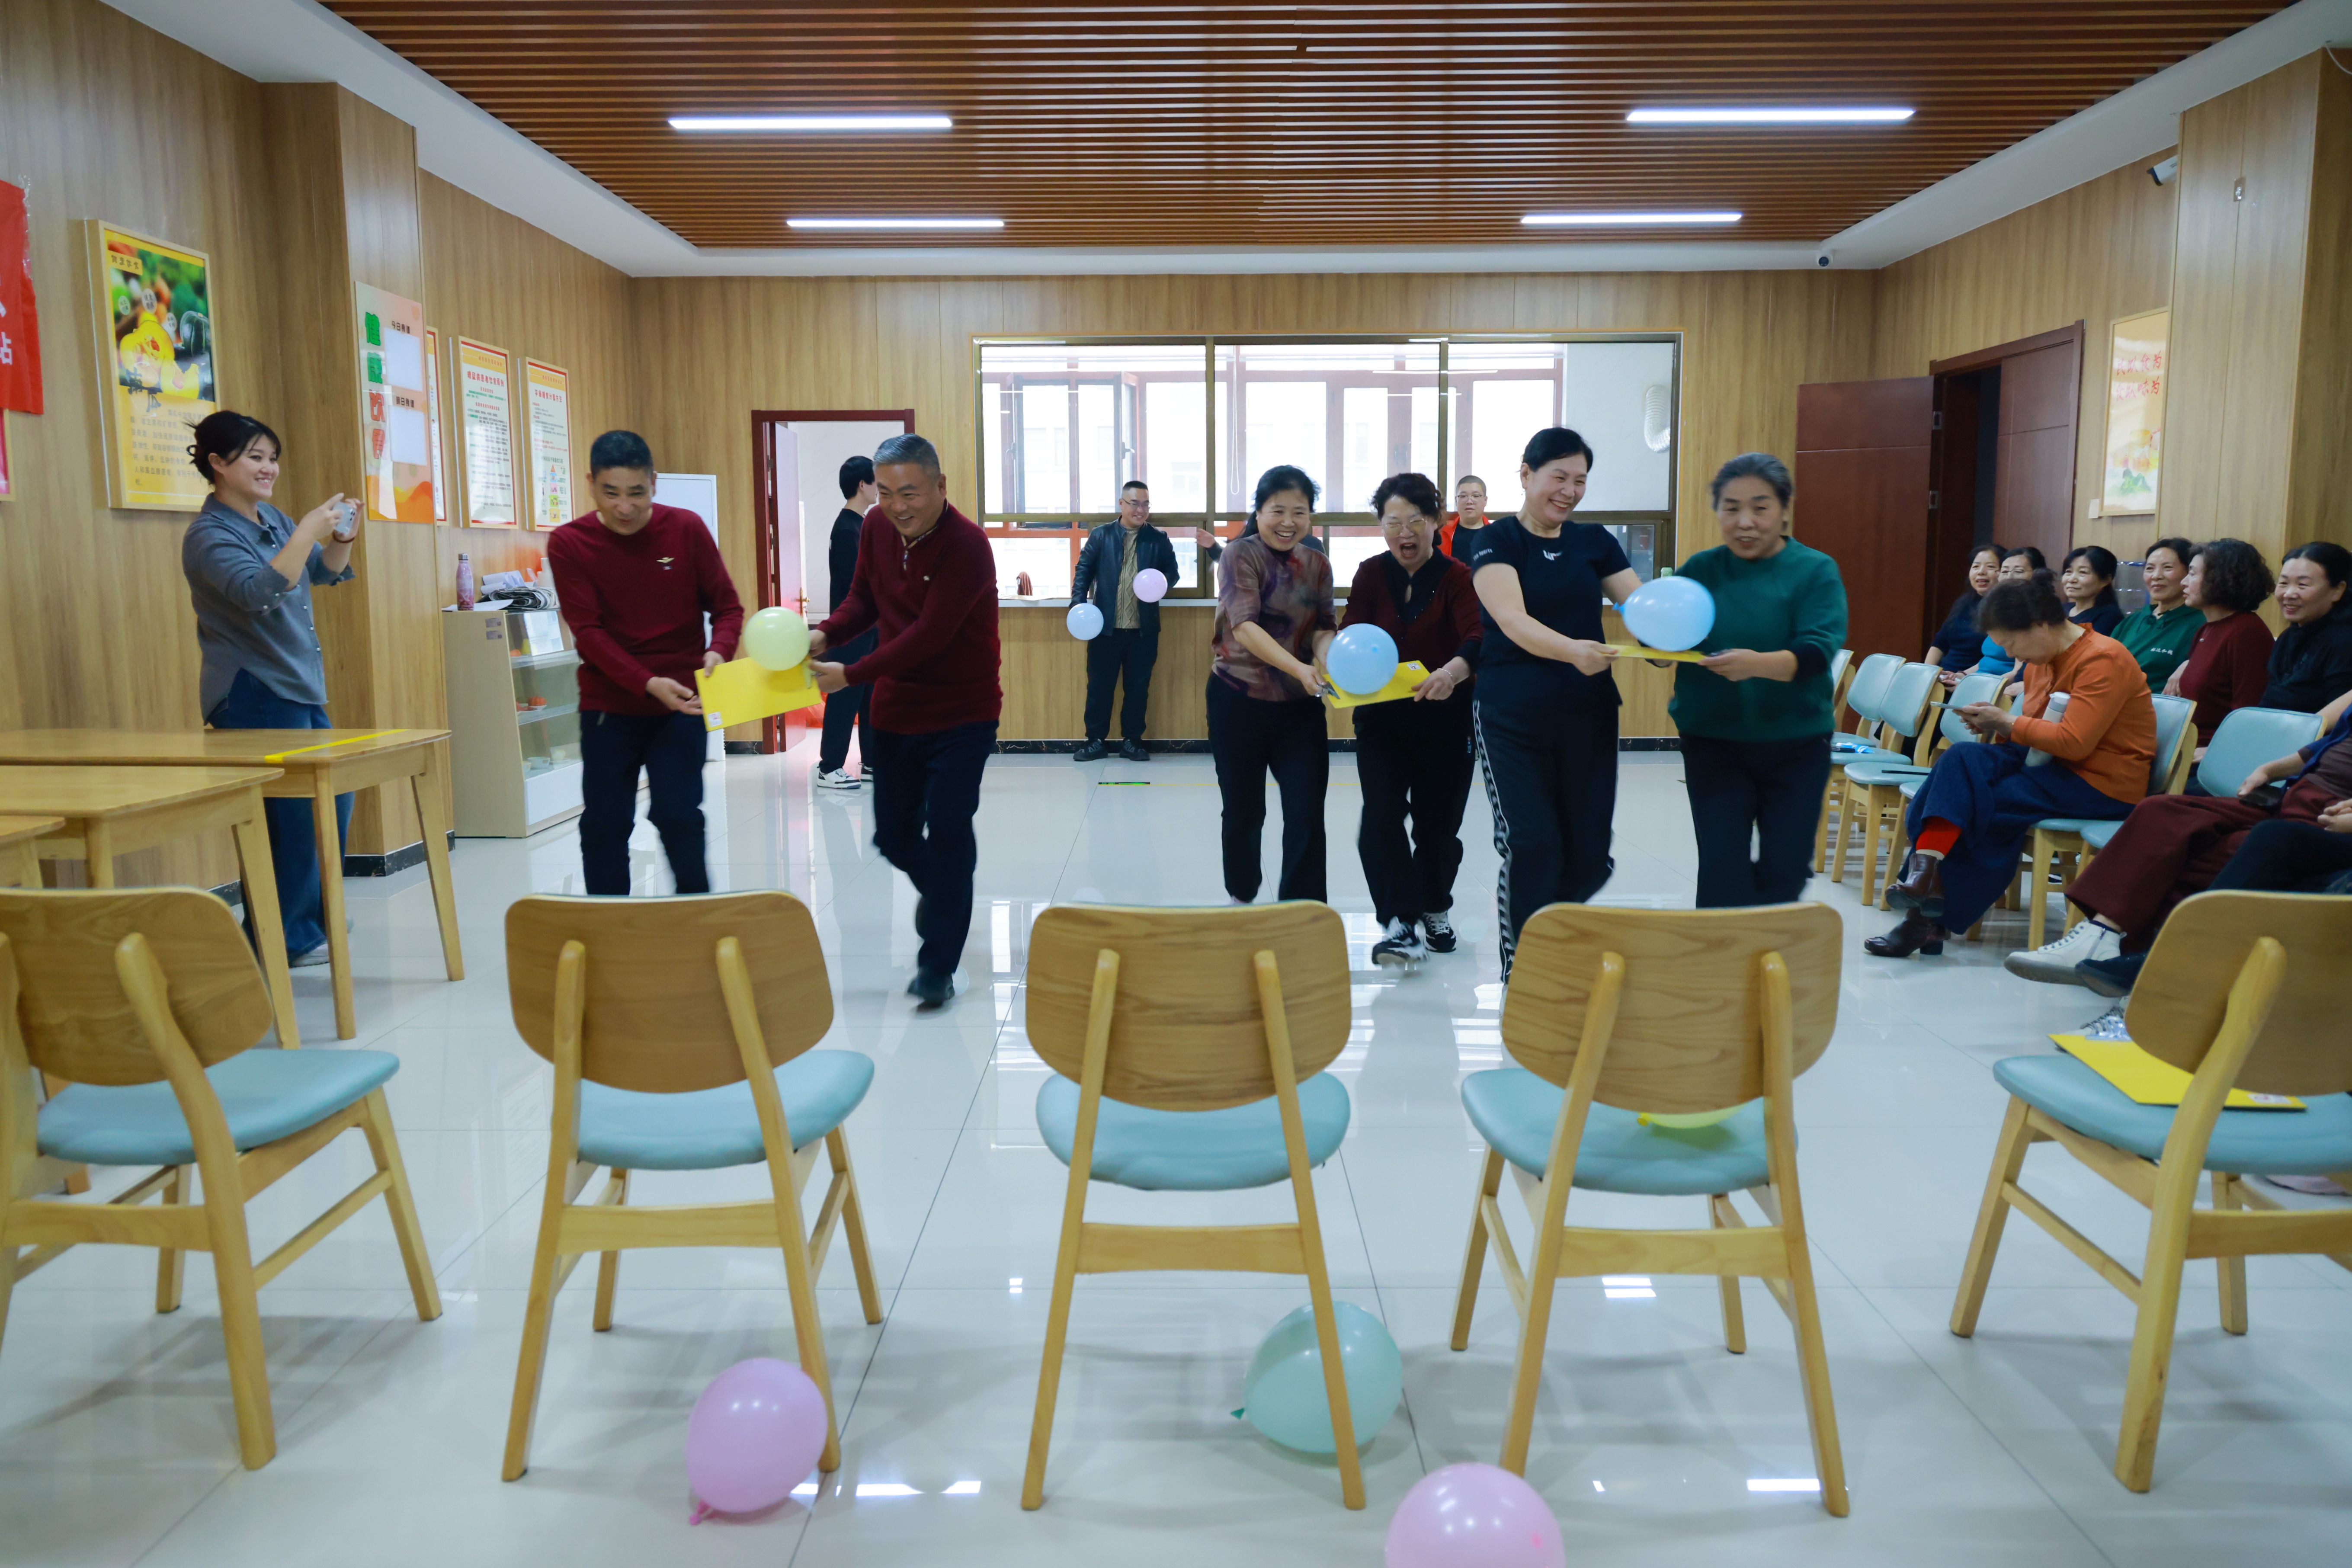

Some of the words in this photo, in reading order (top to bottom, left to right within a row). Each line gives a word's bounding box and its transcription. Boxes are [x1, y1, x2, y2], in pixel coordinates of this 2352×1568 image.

[391, 321, 410, 334] 今日食谱
[365, 312, 387, 460] 健康饮食
